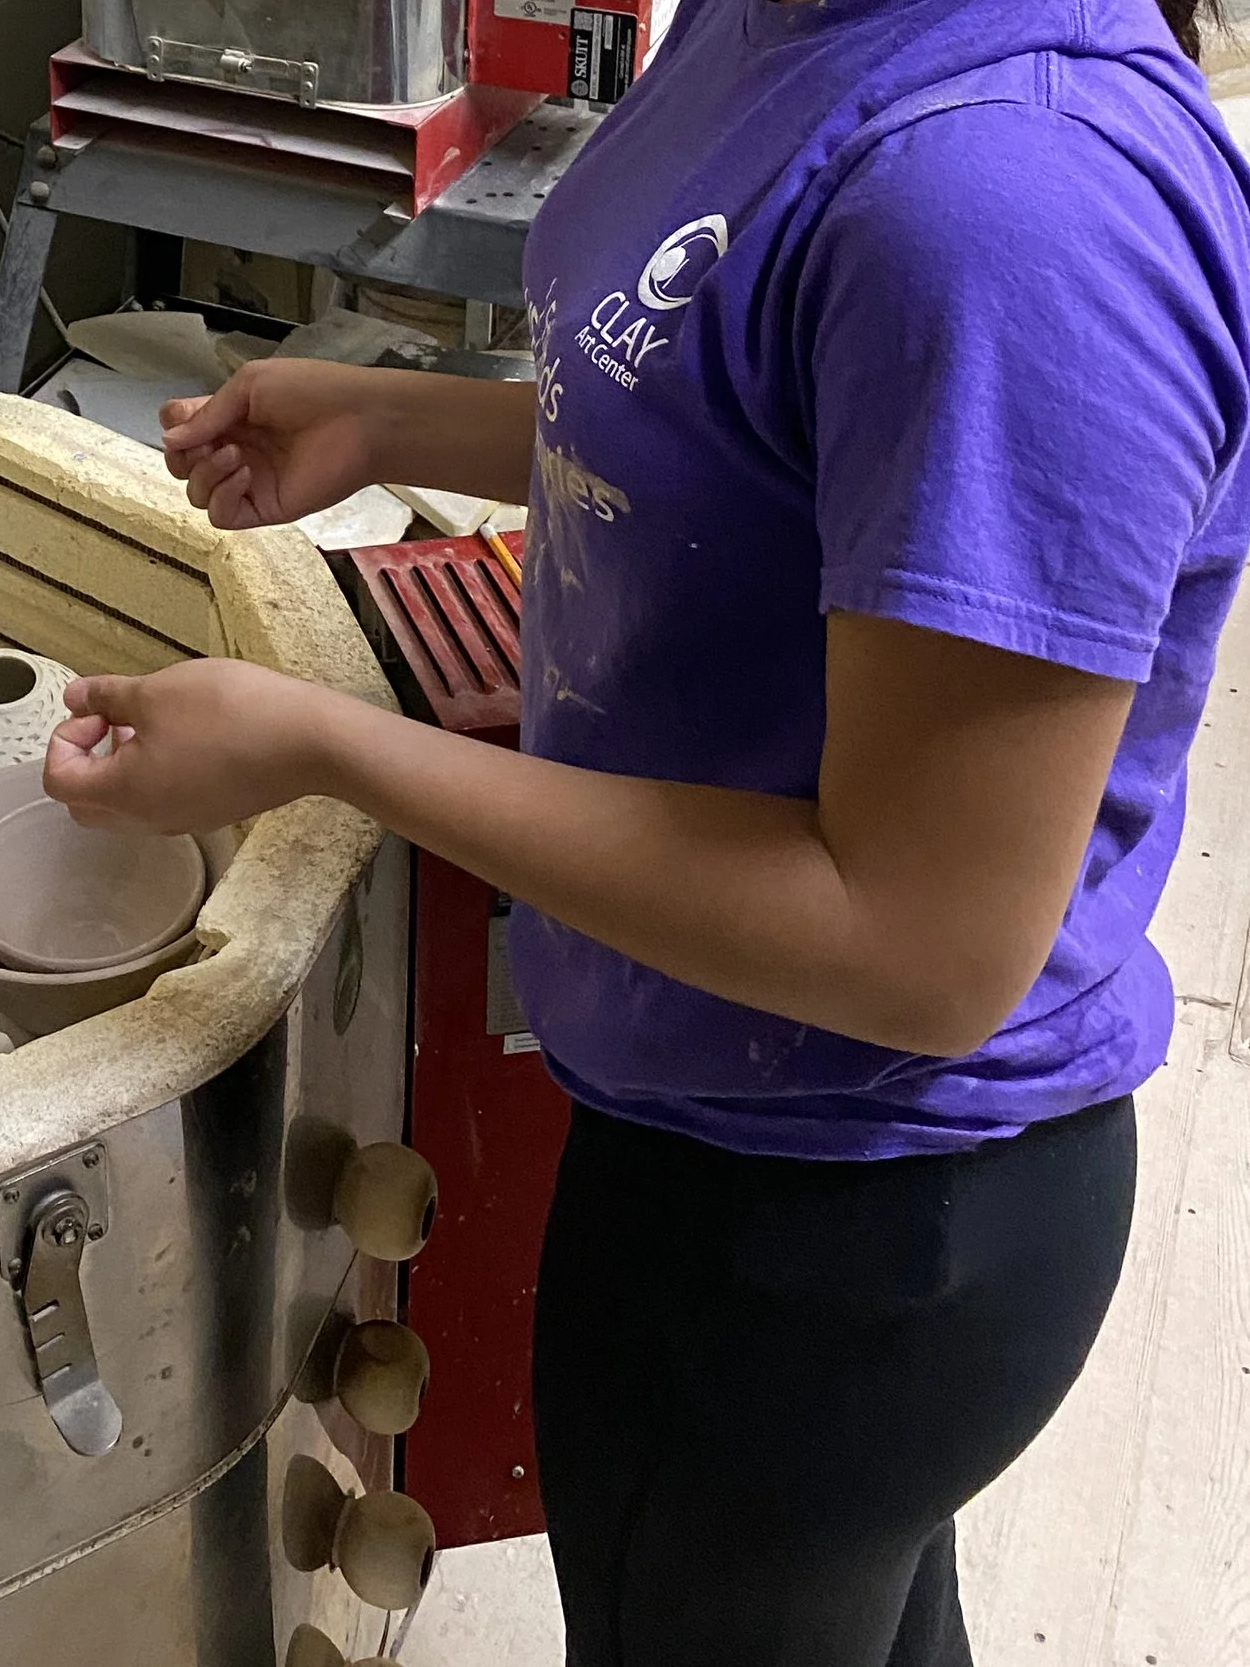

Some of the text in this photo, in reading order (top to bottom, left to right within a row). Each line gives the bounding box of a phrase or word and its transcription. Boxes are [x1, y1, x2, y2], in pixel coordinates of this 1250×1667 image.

[574, 35, 589, 79] SKUTT
[574, 325, 639, 392] Art Center
[591, 291, 669, 368] CLAY
